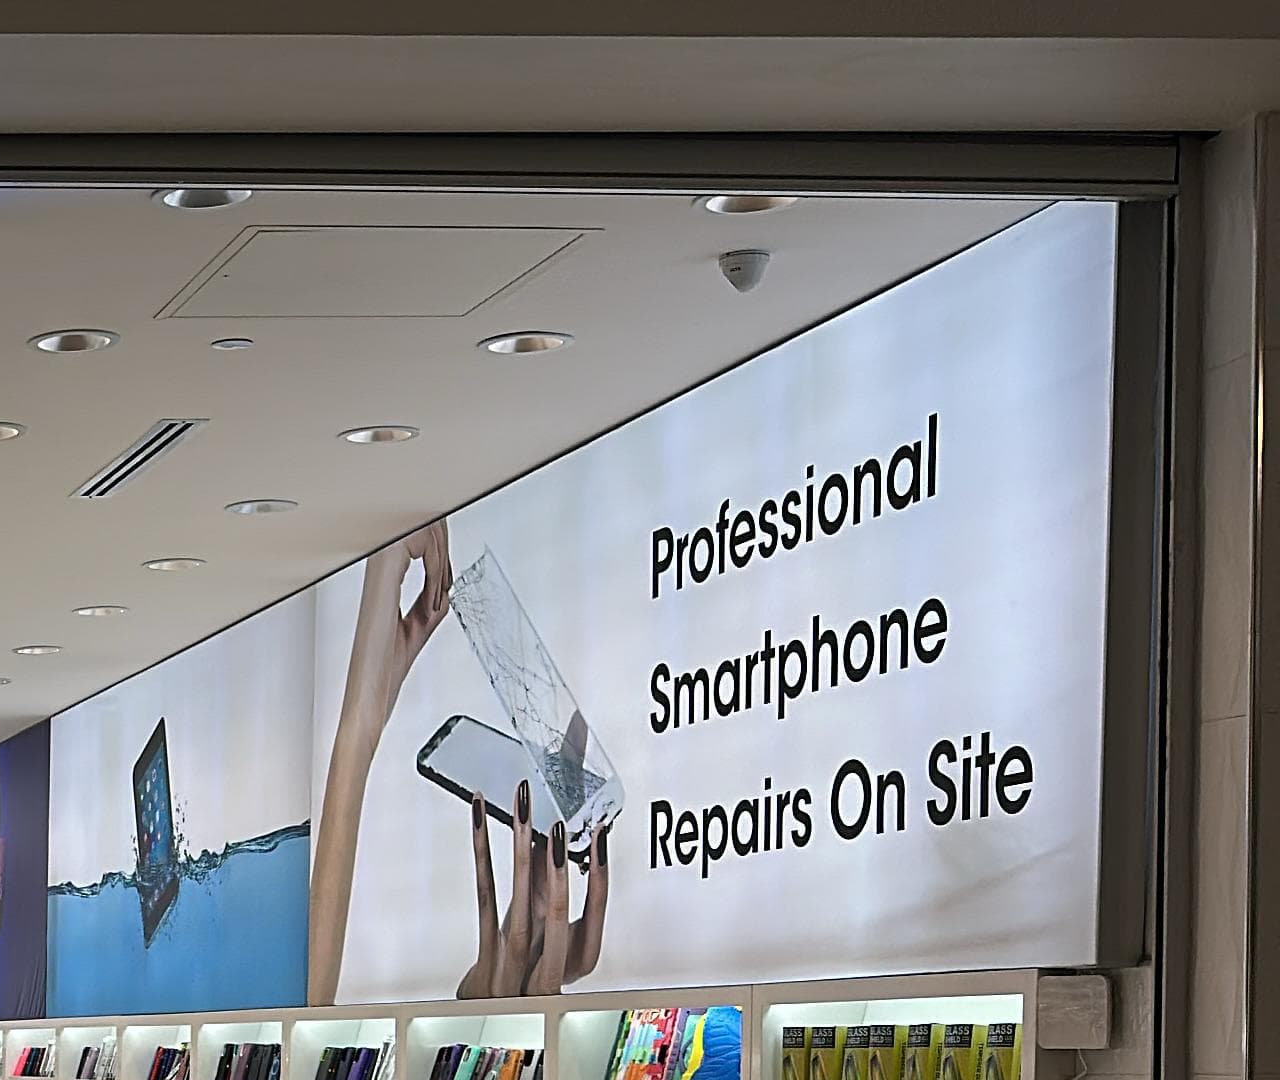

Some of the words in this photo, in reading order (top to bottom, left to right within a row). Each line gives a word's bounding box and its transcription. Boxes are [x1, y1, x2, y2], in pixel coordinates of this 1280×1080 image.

[651, 412, 939, 600] Professional
[649, 597, 948, 735] Smartphone
[649, 776, 813, 880] Repairs
[829, 758, 906, 842] On
[926, 731, 1034, 827] Site
